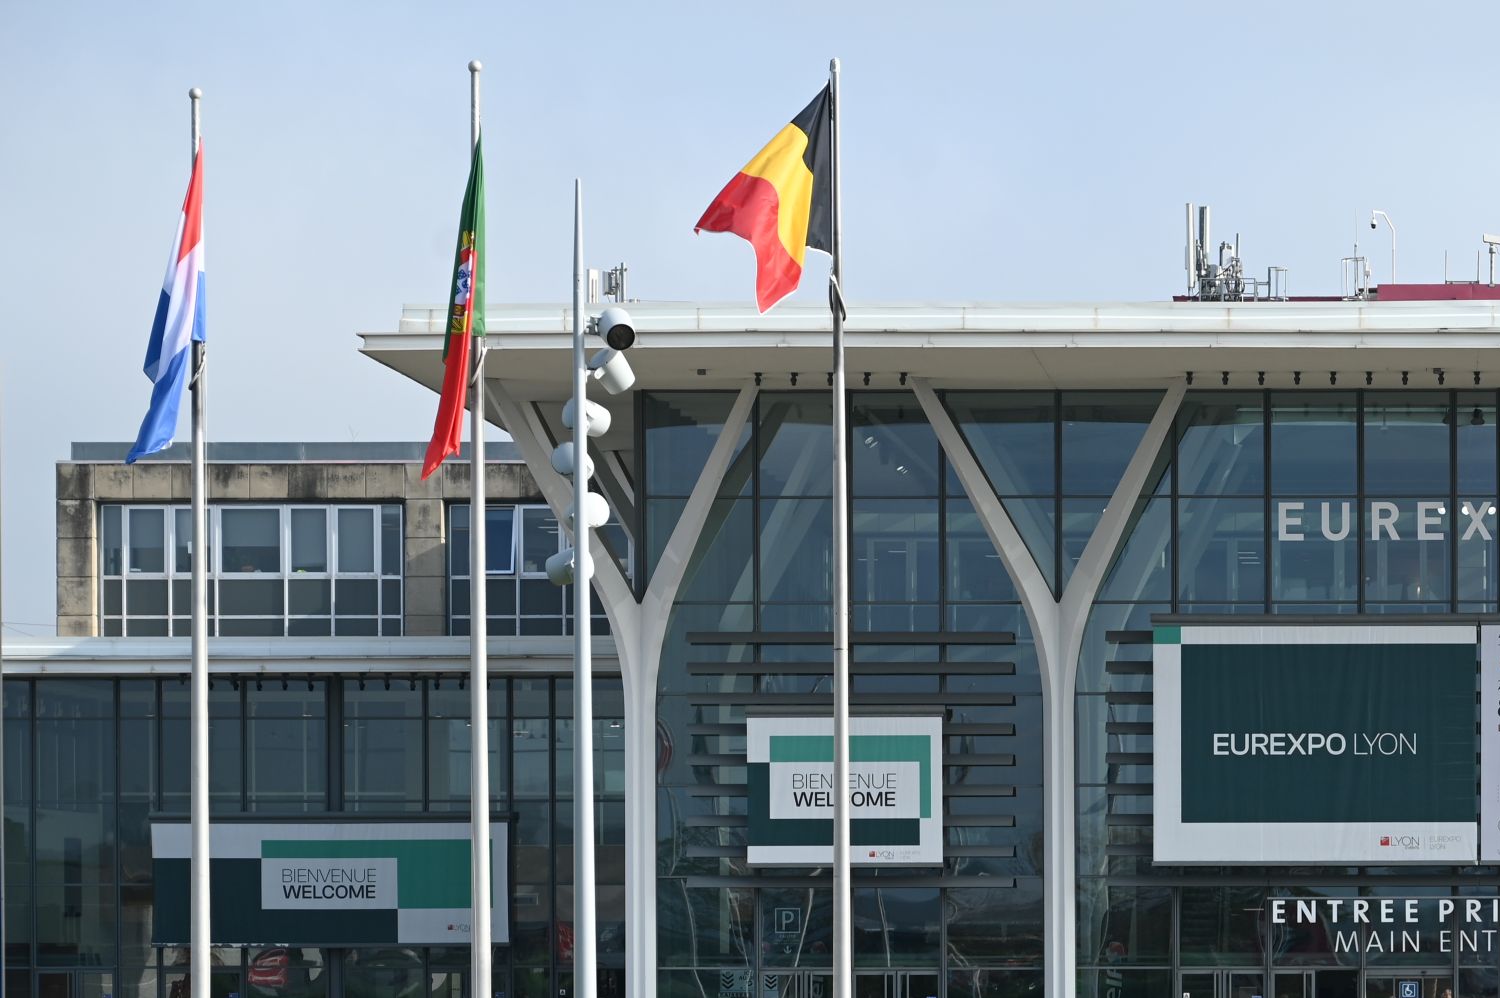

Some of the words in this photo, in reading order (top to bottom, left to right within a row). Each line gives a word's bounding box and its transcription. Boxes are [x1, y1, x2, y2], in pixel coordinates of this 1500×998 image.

[1212, 733, 1346, 756] EUREXPO
[1353, 732, 1418, 756] LYON
[791, 772, 898, 790] BIENENUE
[793, 791, 897, 808] WELOME
[1391, 836, 1420, 847] LYON
[281, 867, 377, 884] BIENVENUE
[282, 884, 377, 899] WELCOME
[1272, 901, 1419, 924] ENTREE
[1335, 930, 1420, 953] MAIN
